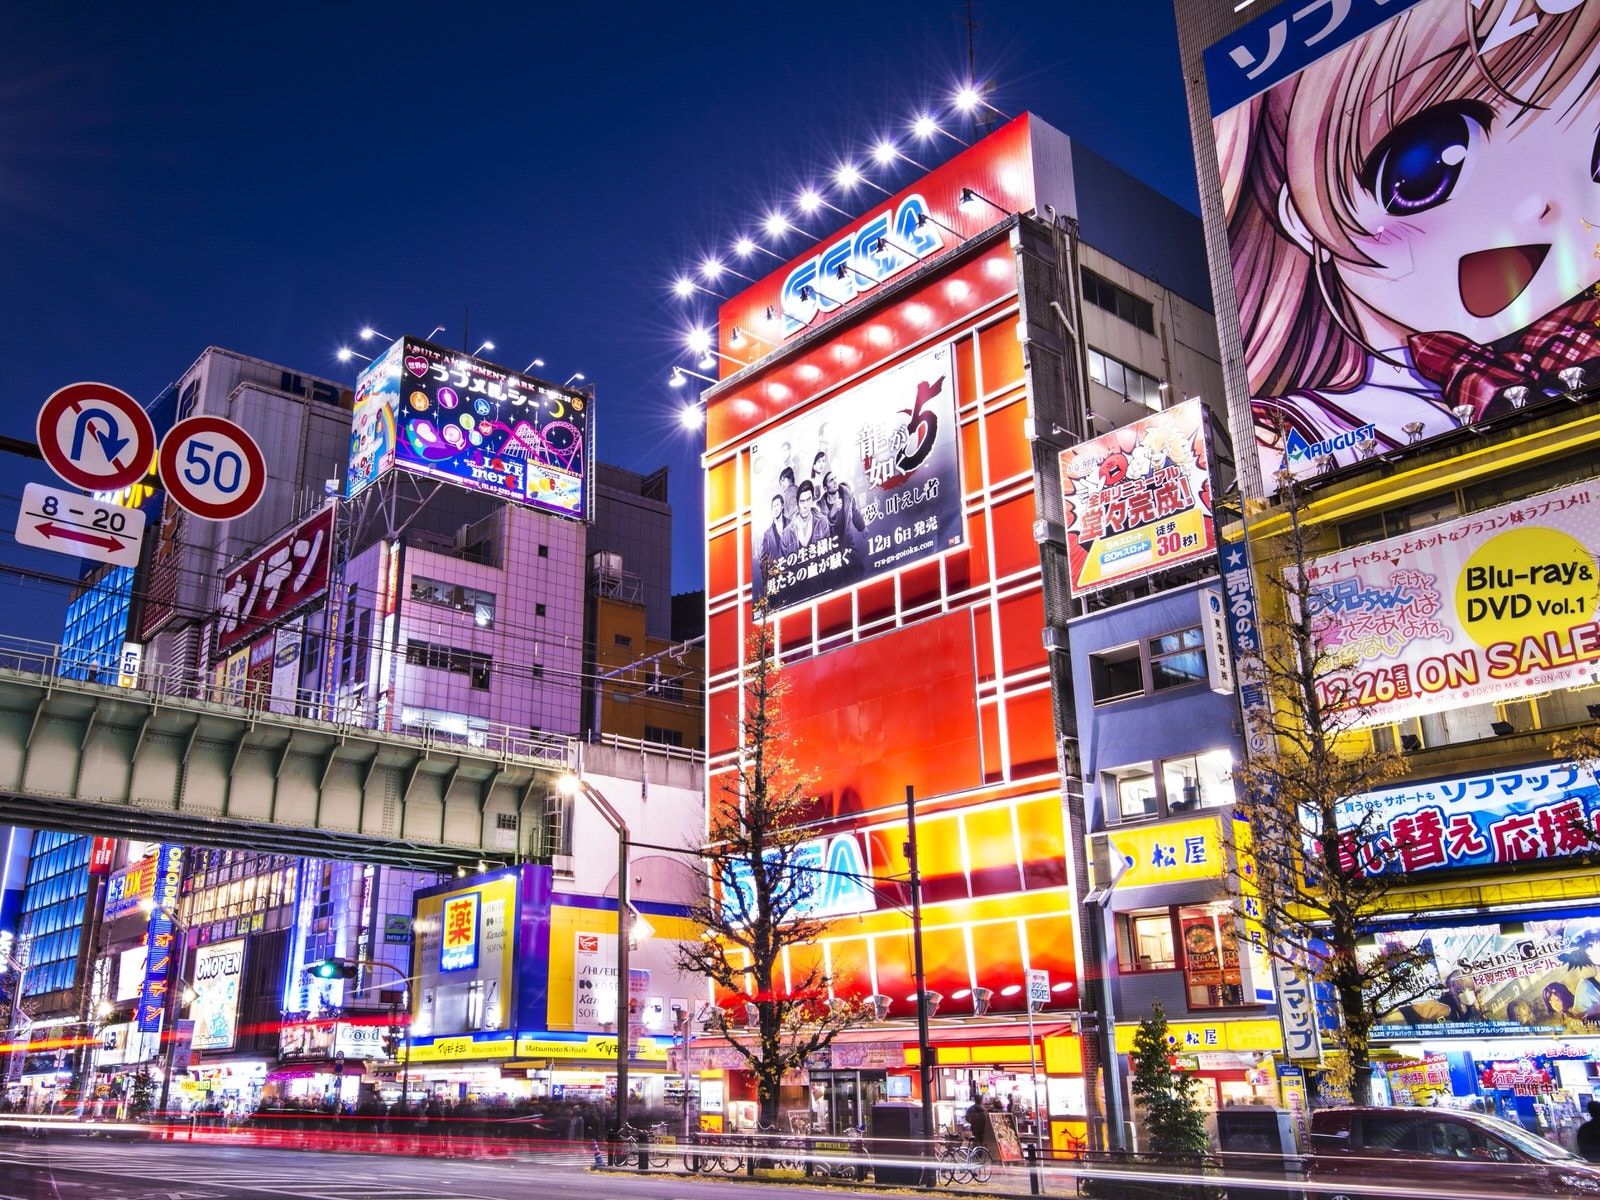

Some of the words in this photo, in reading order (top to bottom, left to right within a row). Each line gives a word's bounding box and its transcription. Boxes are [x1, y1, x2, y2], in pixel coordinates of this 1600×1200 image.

[780, 193, 945, 340] SEGA
[1310, 423, 1376, 458] AUGUST
[184, 440, 243, 493] 50
[41, 496, 59, 517] 8
[92, 508, 127, 532] 20
[864, 478, 940, 526] 夢、叶えし者
[1078, 476, 1195, 544] 堂々完成!
[867, 534, 892, 556] 12月
[894, 526, 912, 545] 6日
[914, 515, 938, 538] 発売
[1156, 521, 1176, 535] 徒歩
[777, 535, 840, 572] その生き様に
[1467, 593, 1533, 623] DVD
[1540, 596, 1587, 617] Vol.1
[1416, 649, 1477, 695] ON
[1486, 620, 1600, 680] SALE
[1384, 791, 1436, 807] サポートも
[1441, 763, 1579, 804] ソフマップ
[1152, 835, 1208, 869] 松屋
[448, 899, 473, 945] 薬
[1186, 1028, 1218, 1046] 松屋
[1513, 1082, 1559, 1097] 開催中!
